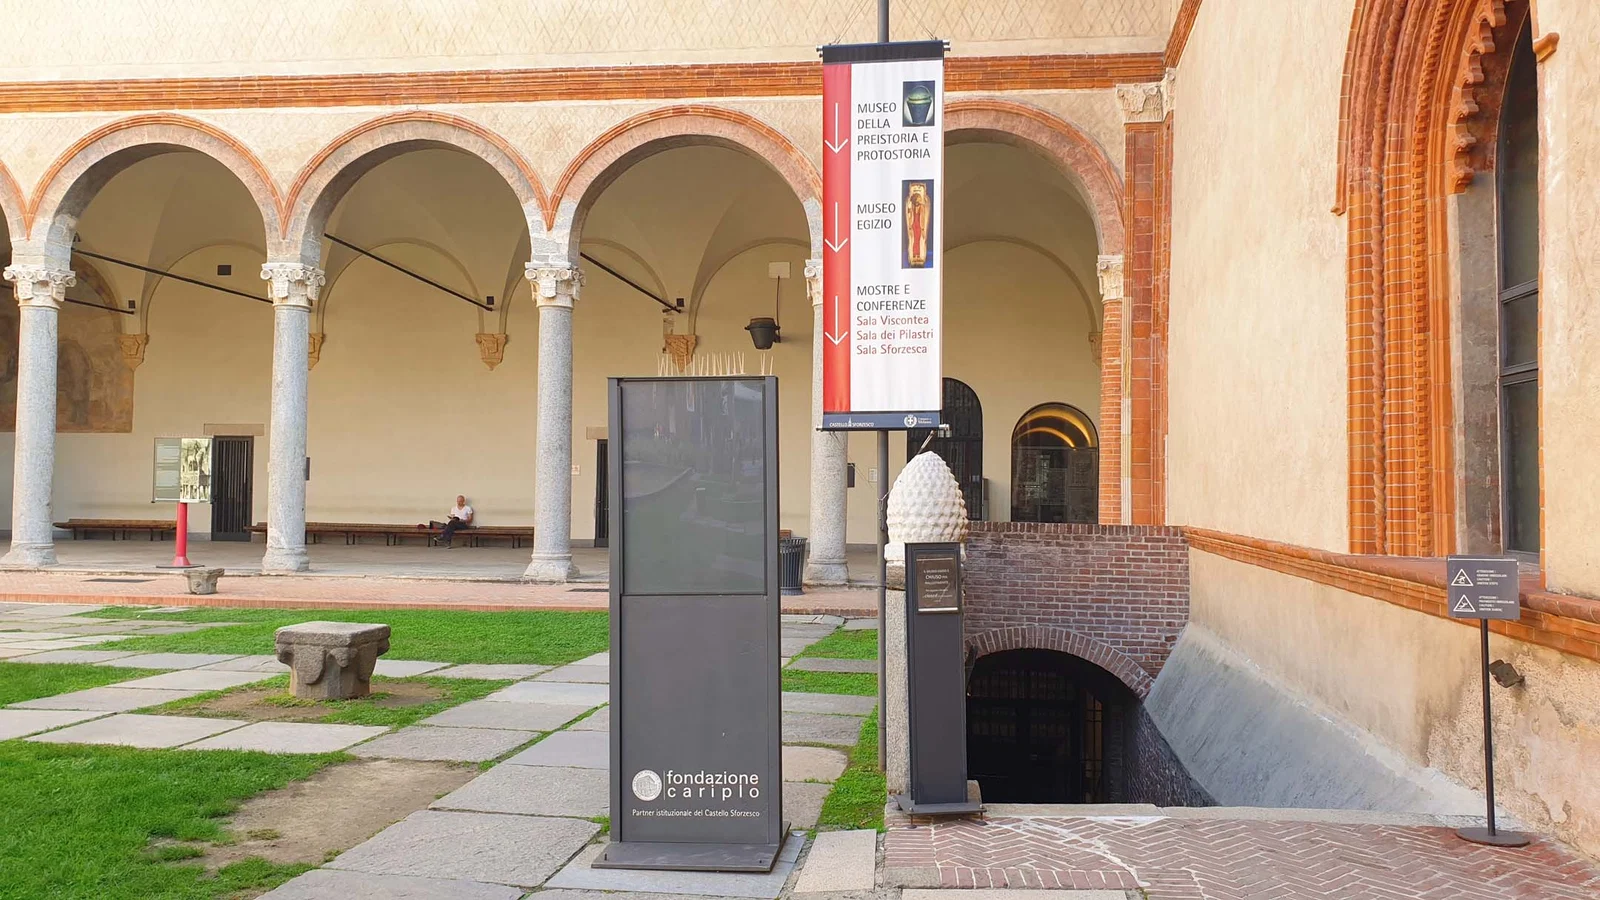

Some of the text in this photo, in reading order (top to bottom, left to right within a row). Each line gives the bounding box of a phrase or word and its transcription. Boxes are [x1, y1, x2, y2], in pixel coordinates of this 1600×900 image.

[857, 102, 897, 114] MUSEO
[857, 119, 891, 130] DELLA
[857, 133, 929, 146] PREISTORIA E
[857, 149, 931, 162] PROTOSTORIA
[857, 203, 896, 215] MUSEO
[857, 219, 892, 231] EGIZIO
[856, 284, 910, 296] MOSTRE E
[856, 300, 926, 312] CONFERENZE
[856, 316, 929, 327] Sala Viscontea
[856, 329, 934, 341] Sala dei Pilastri
[856, 344, 928, 355] Sala Sforzesca
[667, 770, 759, 785] fondazione
[667, 785, 760, 801] cariplo
[632, 809, 760, 817] Partner istituzionale del Castello Sforzesco
